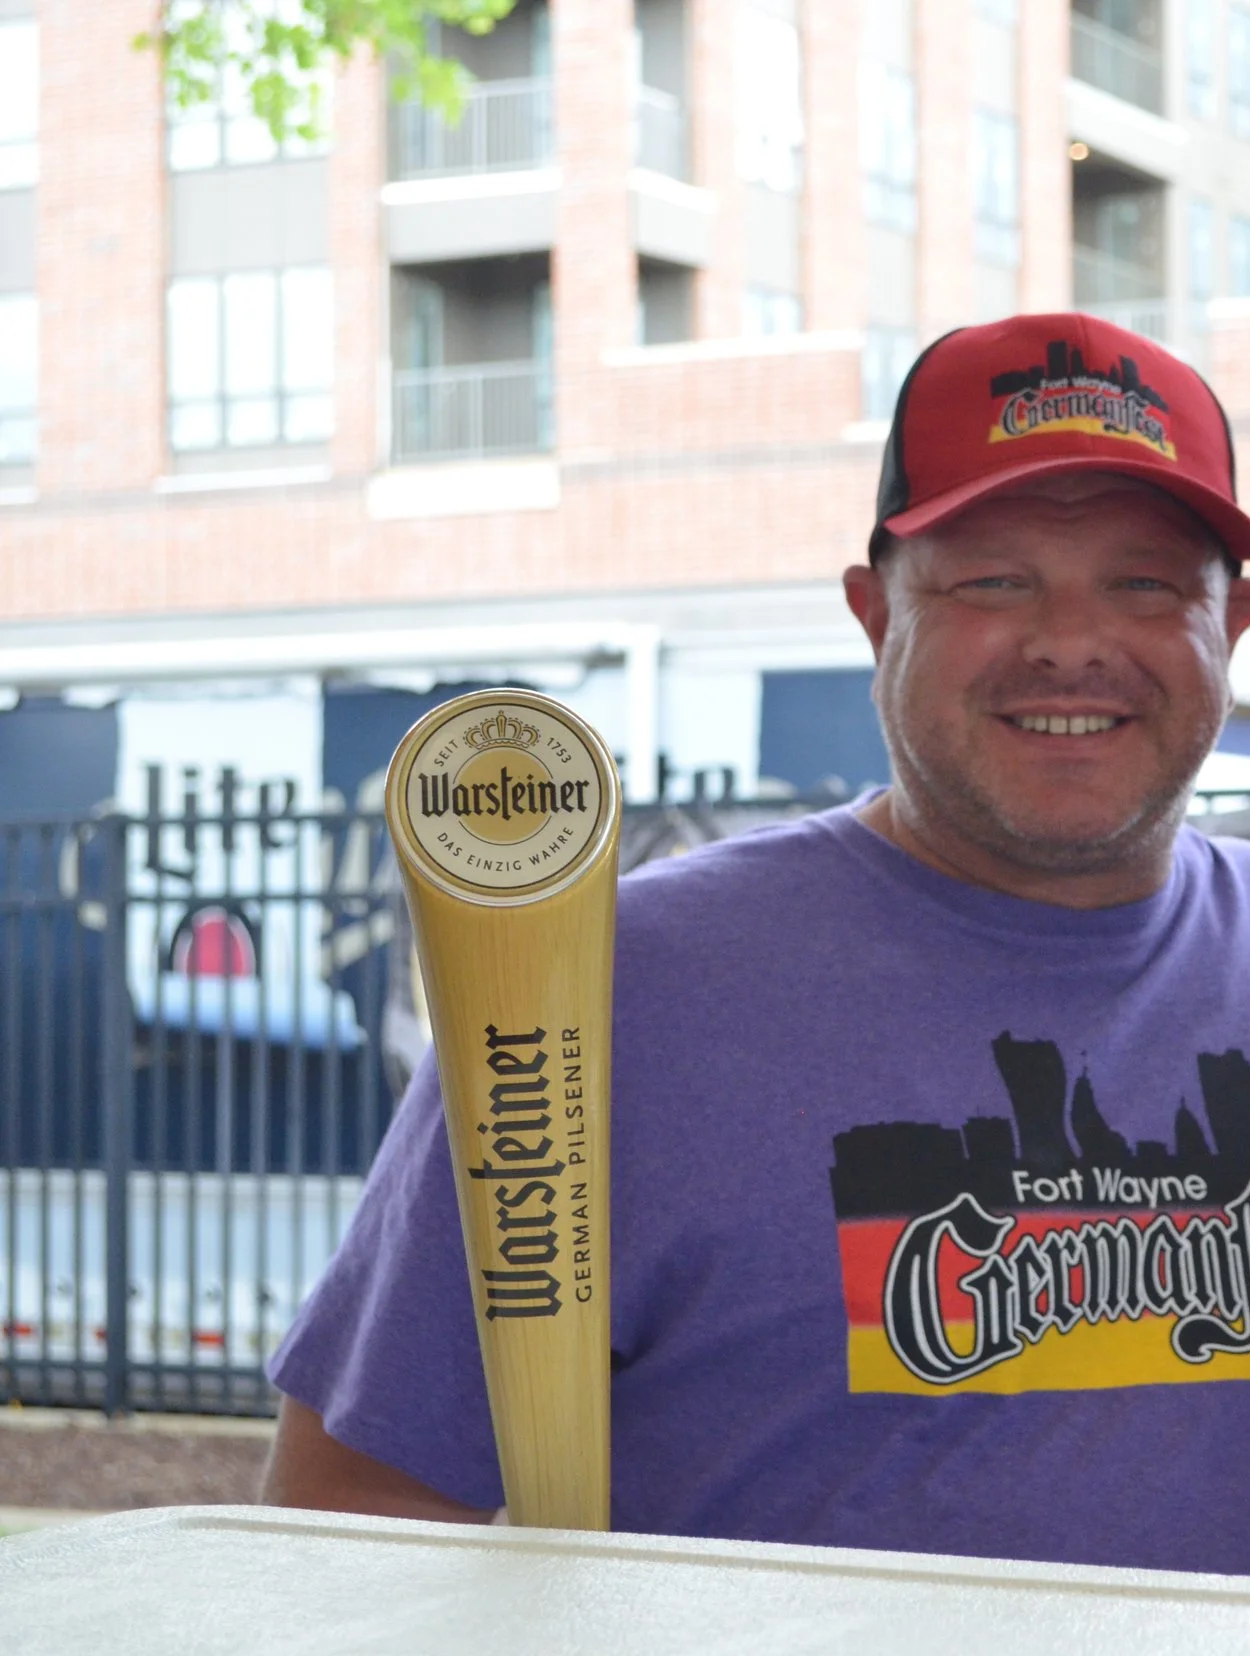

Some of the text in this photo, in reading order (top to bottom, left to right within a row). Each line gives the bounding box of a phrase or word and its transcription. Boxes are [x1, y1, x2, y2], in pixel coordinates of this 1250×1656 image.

[433, 736, 573, 768] SEIT 1753
[417, 766, 591, 822] Warsteiner
[436, 826, 575, 873] DAS EINZIG WAHRE
[467, 1023, 567, 1323] Warsteiner
[561, 1026, 593, 1304] GERMAN PILSENER
[1012, 1166, 1209, 1208] Fort Wayne
